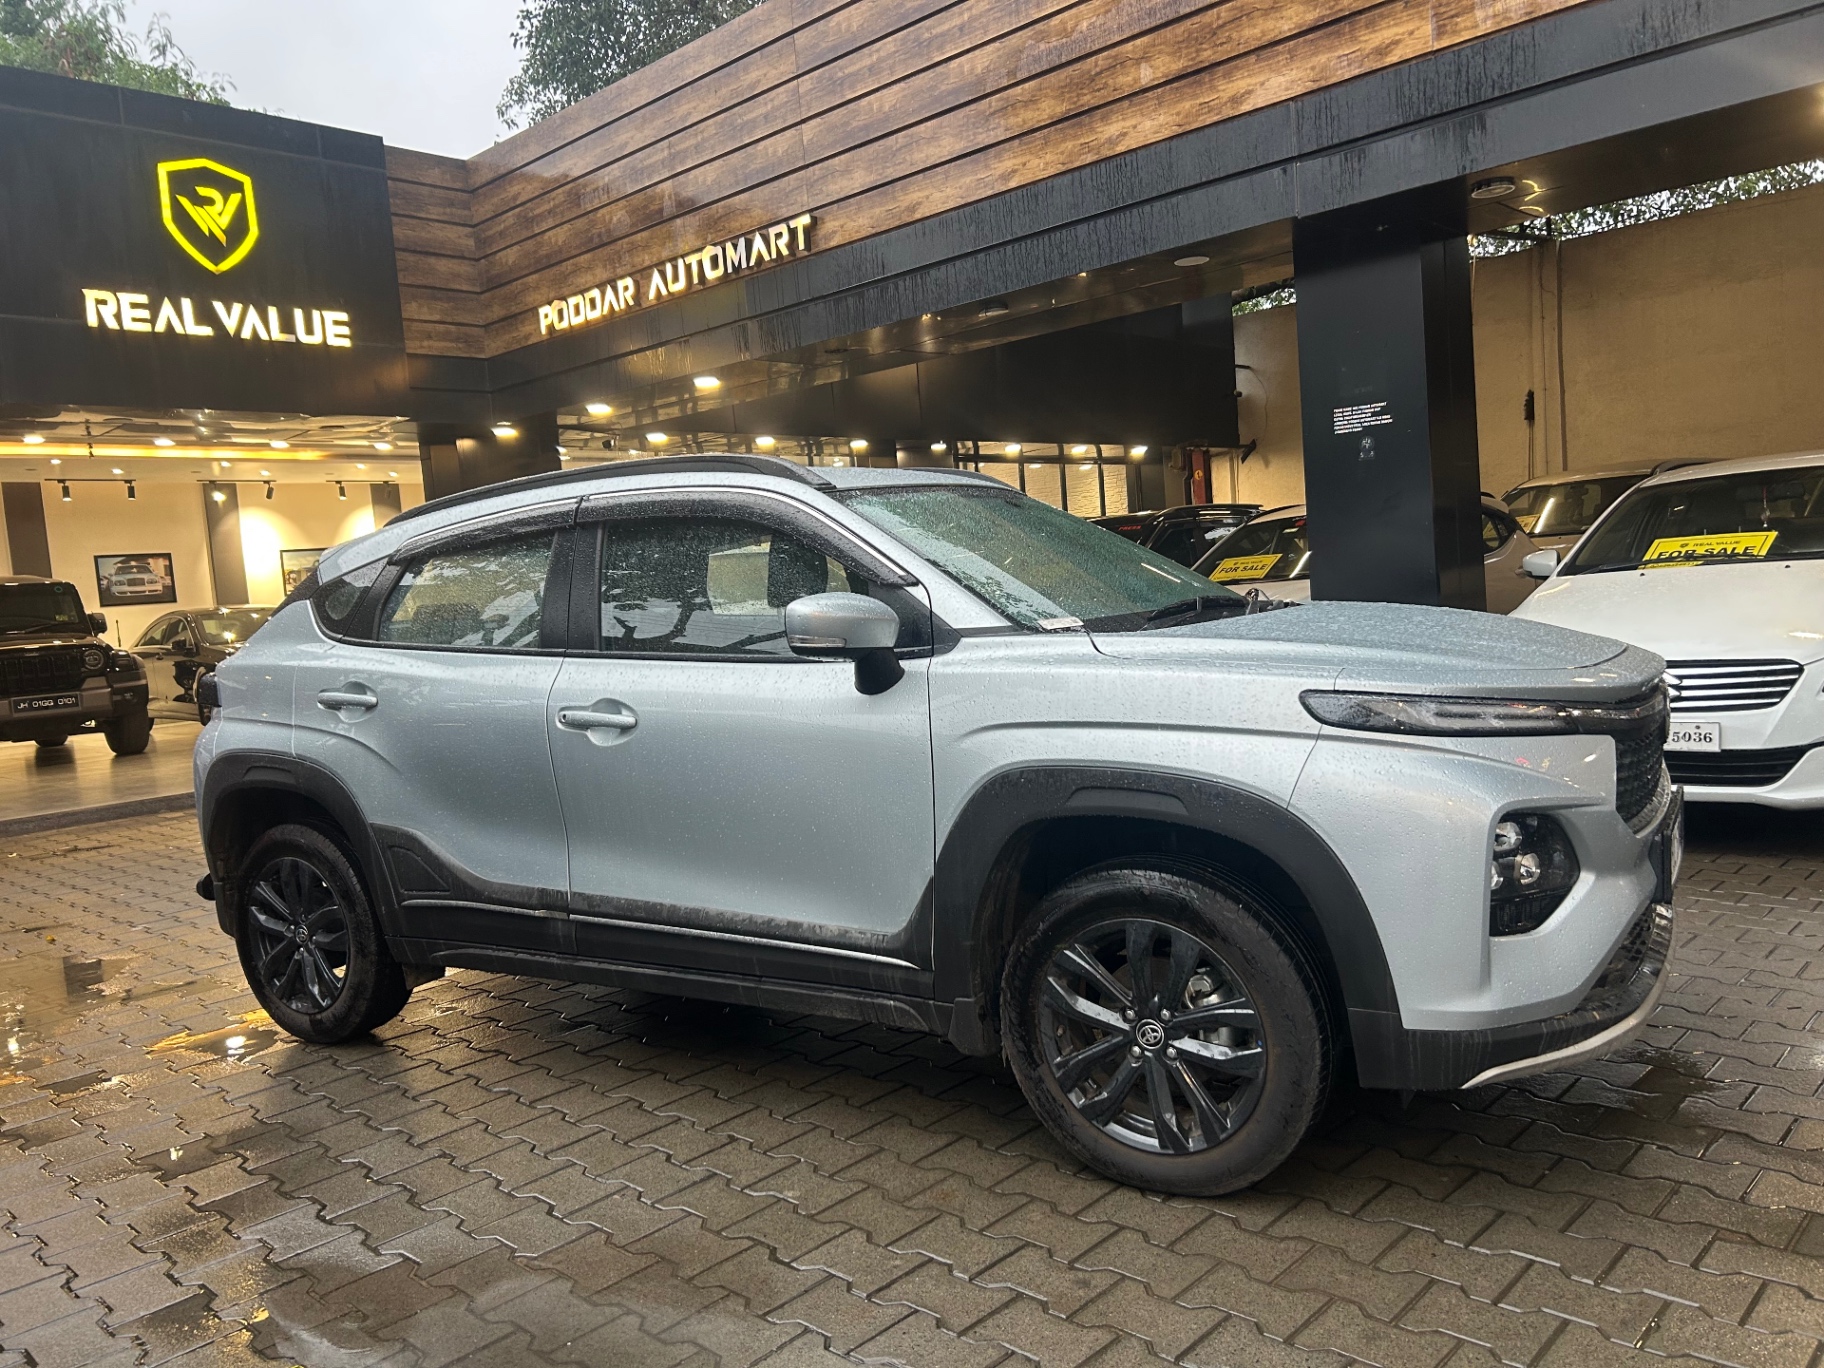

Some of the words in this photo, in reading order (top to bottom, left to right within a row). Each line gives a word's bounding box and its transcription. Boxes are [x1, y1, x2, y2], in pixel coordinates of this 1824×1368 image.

[538, 275, 637, 335] PODDAR
[648, 213, 812, 300] AUTOMART
[81, 288, 214, 337] REAL
[212, 300, 352, 348] VALUE
[1656, 549, 1697, 560] FOR
[1703, 545, 1757, 557] SALE
[1218, 566, 1240, 575] FOR
[1240, 563, 1268, 572] SALE
[1671, 731, 1713, 743] 5036
